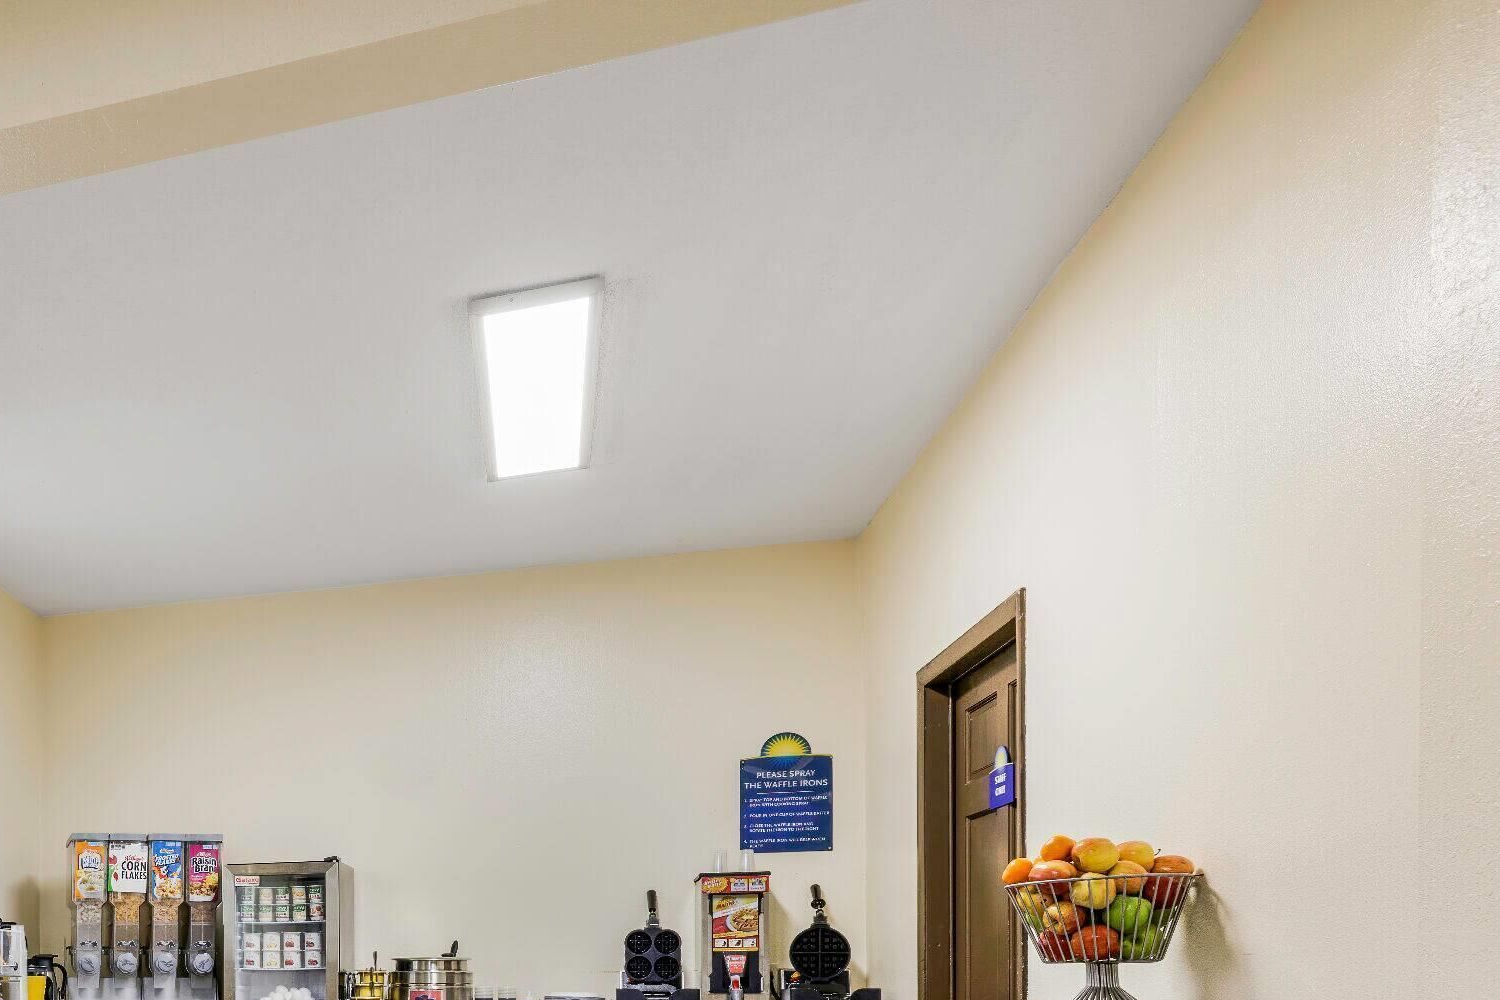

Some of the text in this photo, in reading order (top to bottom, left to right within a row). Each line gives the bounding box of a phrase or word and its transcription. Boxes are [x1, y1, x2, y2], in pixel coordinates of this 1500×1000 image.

[757, 769, 816, 779] PLEASE SPRAY
[764, 780, 798, 788] WAFFLE
[800, 778, 828, 787] IRONS
[121, 860, 147, 871] CORN
[192, 857, 217, 866] Raisin
[194, 864, 214, 873] Bran
[121, 871, 147, 880] FLAKES
